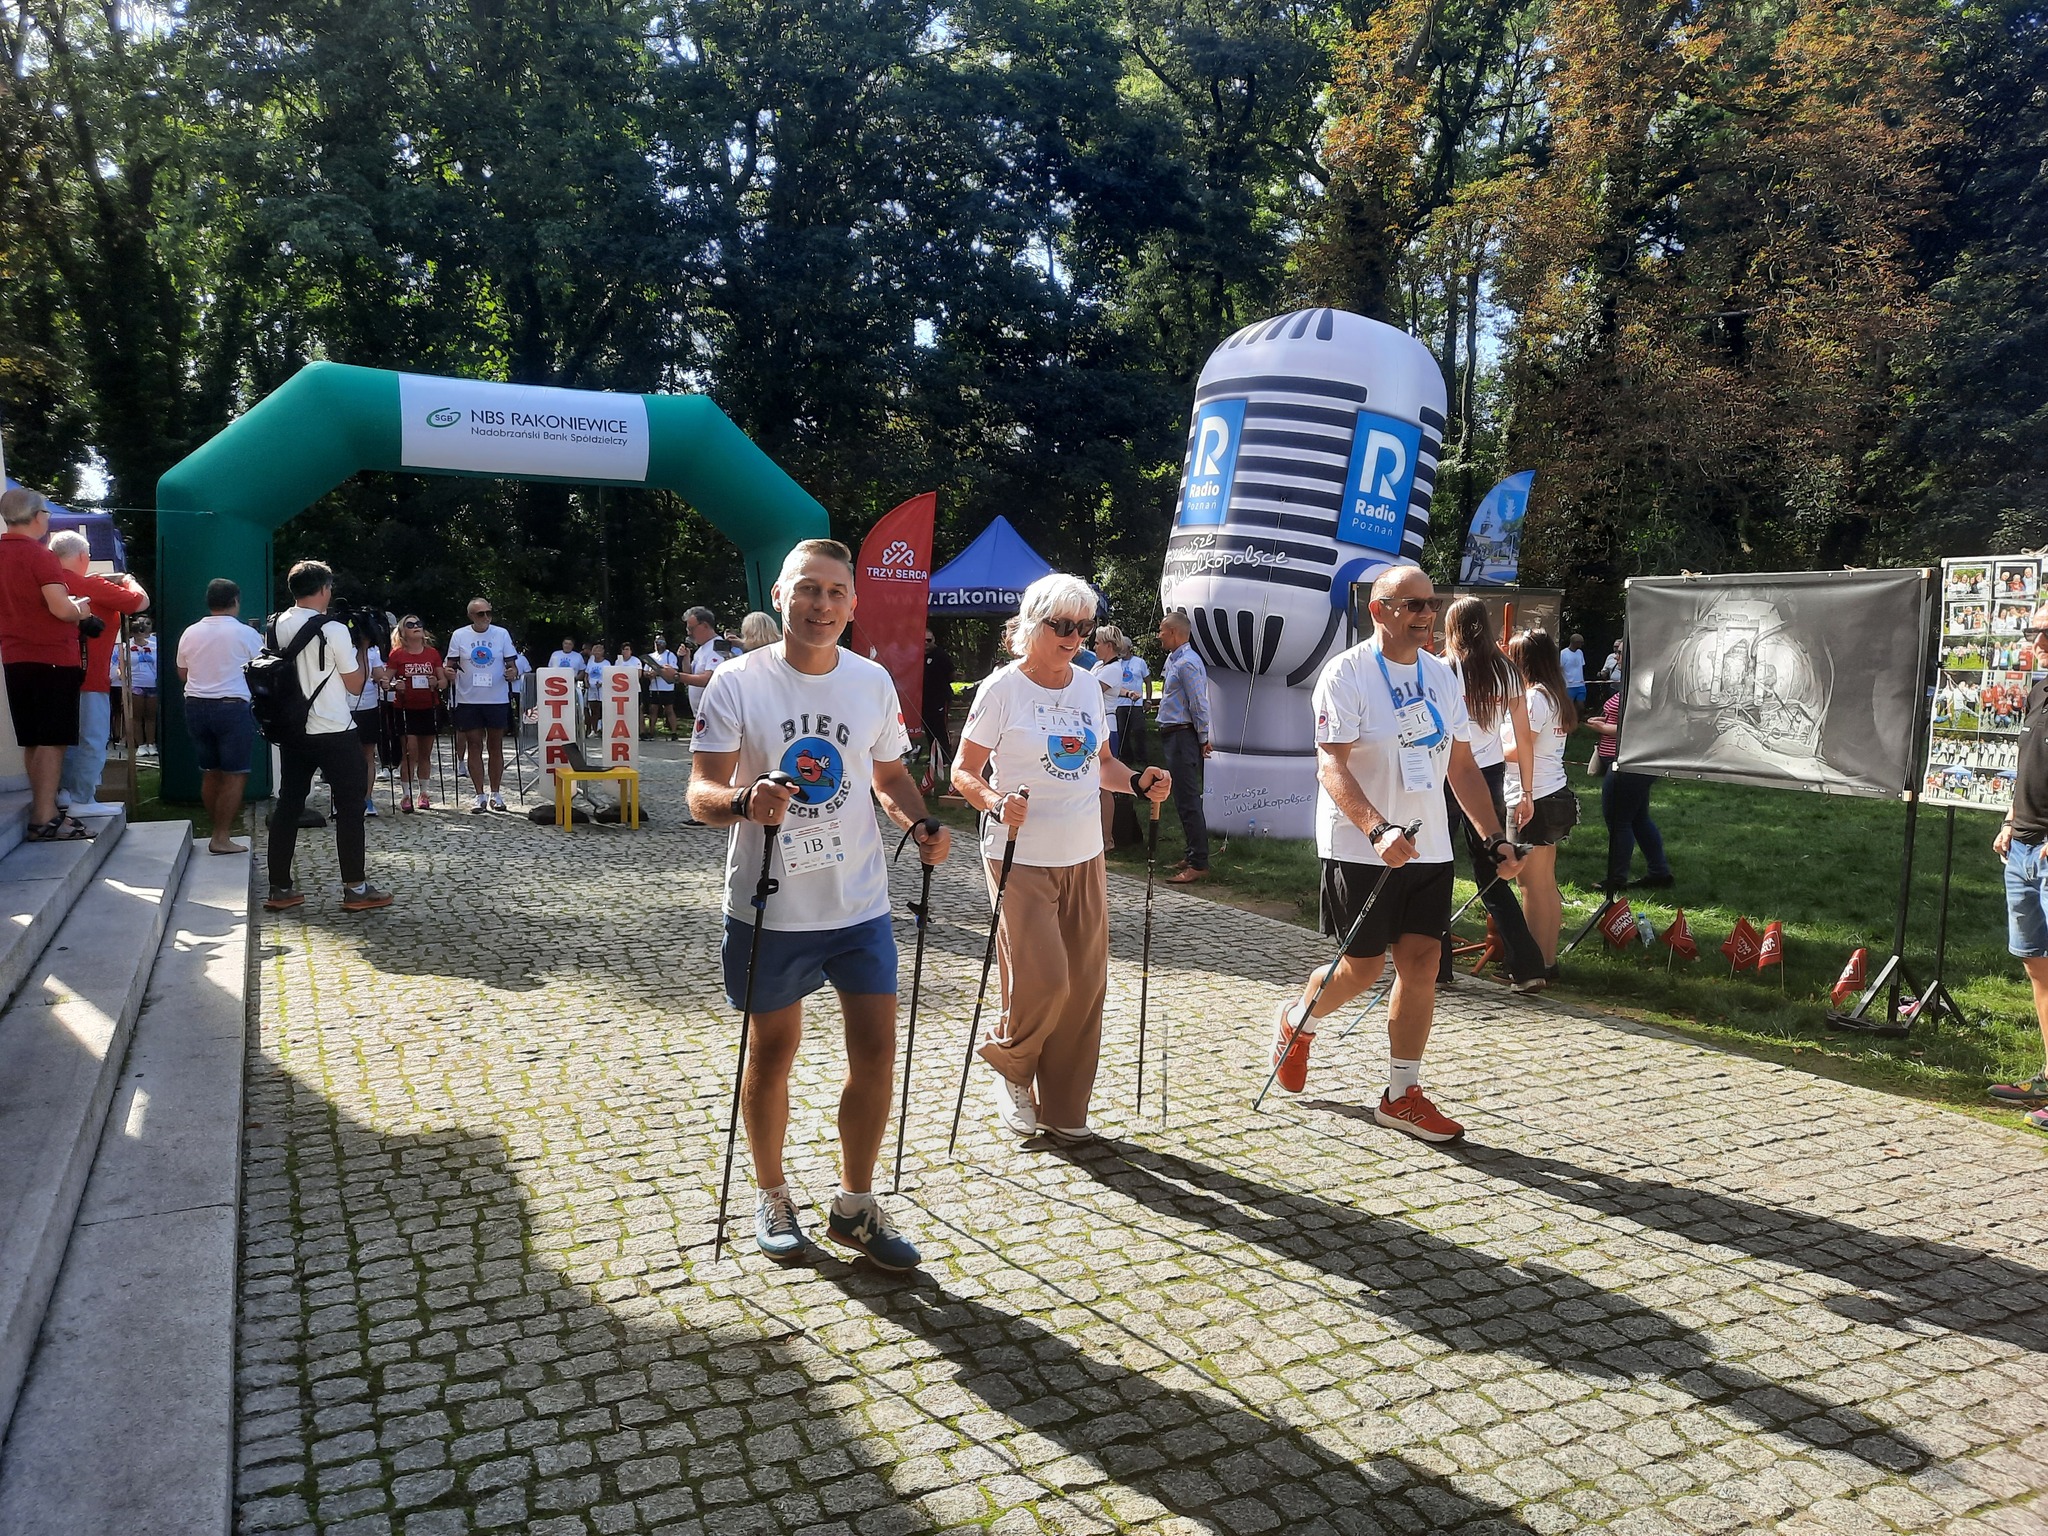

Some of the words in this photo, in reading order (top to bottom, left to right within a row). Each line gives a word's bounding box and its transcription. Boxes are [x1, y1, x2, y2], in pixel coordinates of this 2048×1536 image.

[434, 414, 454, 422] SGB
[471, 409, 505, 425] NBS
[511, 412, 628, 434] RAKONIEWICE
[471, 426, 541, 440] Nadobrzański
[543, 431, 568, 442] Bank
[570, 432, 628, 447] Spółdzielczy
[1188, 483, 1220, 498] Radio
[1187, 499, 1217, 511] Poznań
[1354, 499, 1397, 524] Radio
[1351, 517, 1394, 537] Poznań
[866, 567, 894, 578] TRZY
[895, 569, 928, 580] SERCA
[1174, 544, 1289, 586] Wielkopolsce
[611, 673, 631, 768] STAR
[780, 713, 851, 748] BIEG
[1040, 753, 1080, 781] TRZECH
[787, 803, 820, 819] ECH
[825, 780, 852, 815] SERC
[1223, 787, 1269, 805] pierwsze
[1223, 809, 1233, 817] w
[1235, 793, 1313, 814] Wielkopolsce
[803, 838, 824, 854] 1B
